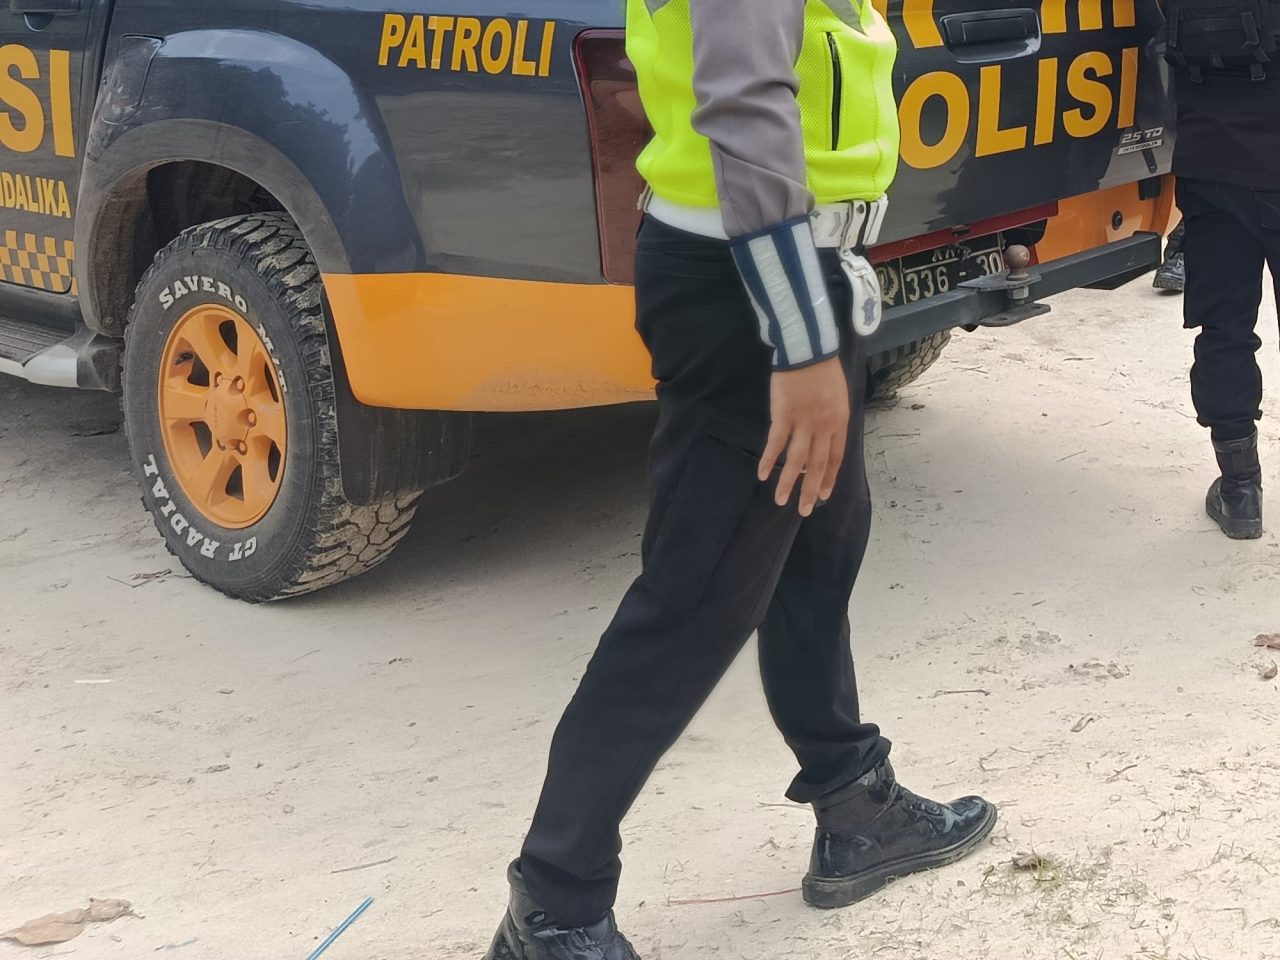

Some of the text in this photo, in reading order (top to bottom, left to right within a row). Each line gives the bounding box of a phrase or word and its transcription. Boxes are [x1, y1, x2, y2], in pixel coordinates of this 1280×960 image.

[378, 13, 556, 77] PATROLI
[899, 47, 1139, 169] OLISI
[158, 275, 249, 313] SAVERO
[905, 265, 949, 302] 336
[143, 453, 258, 561] GT RADIAL
